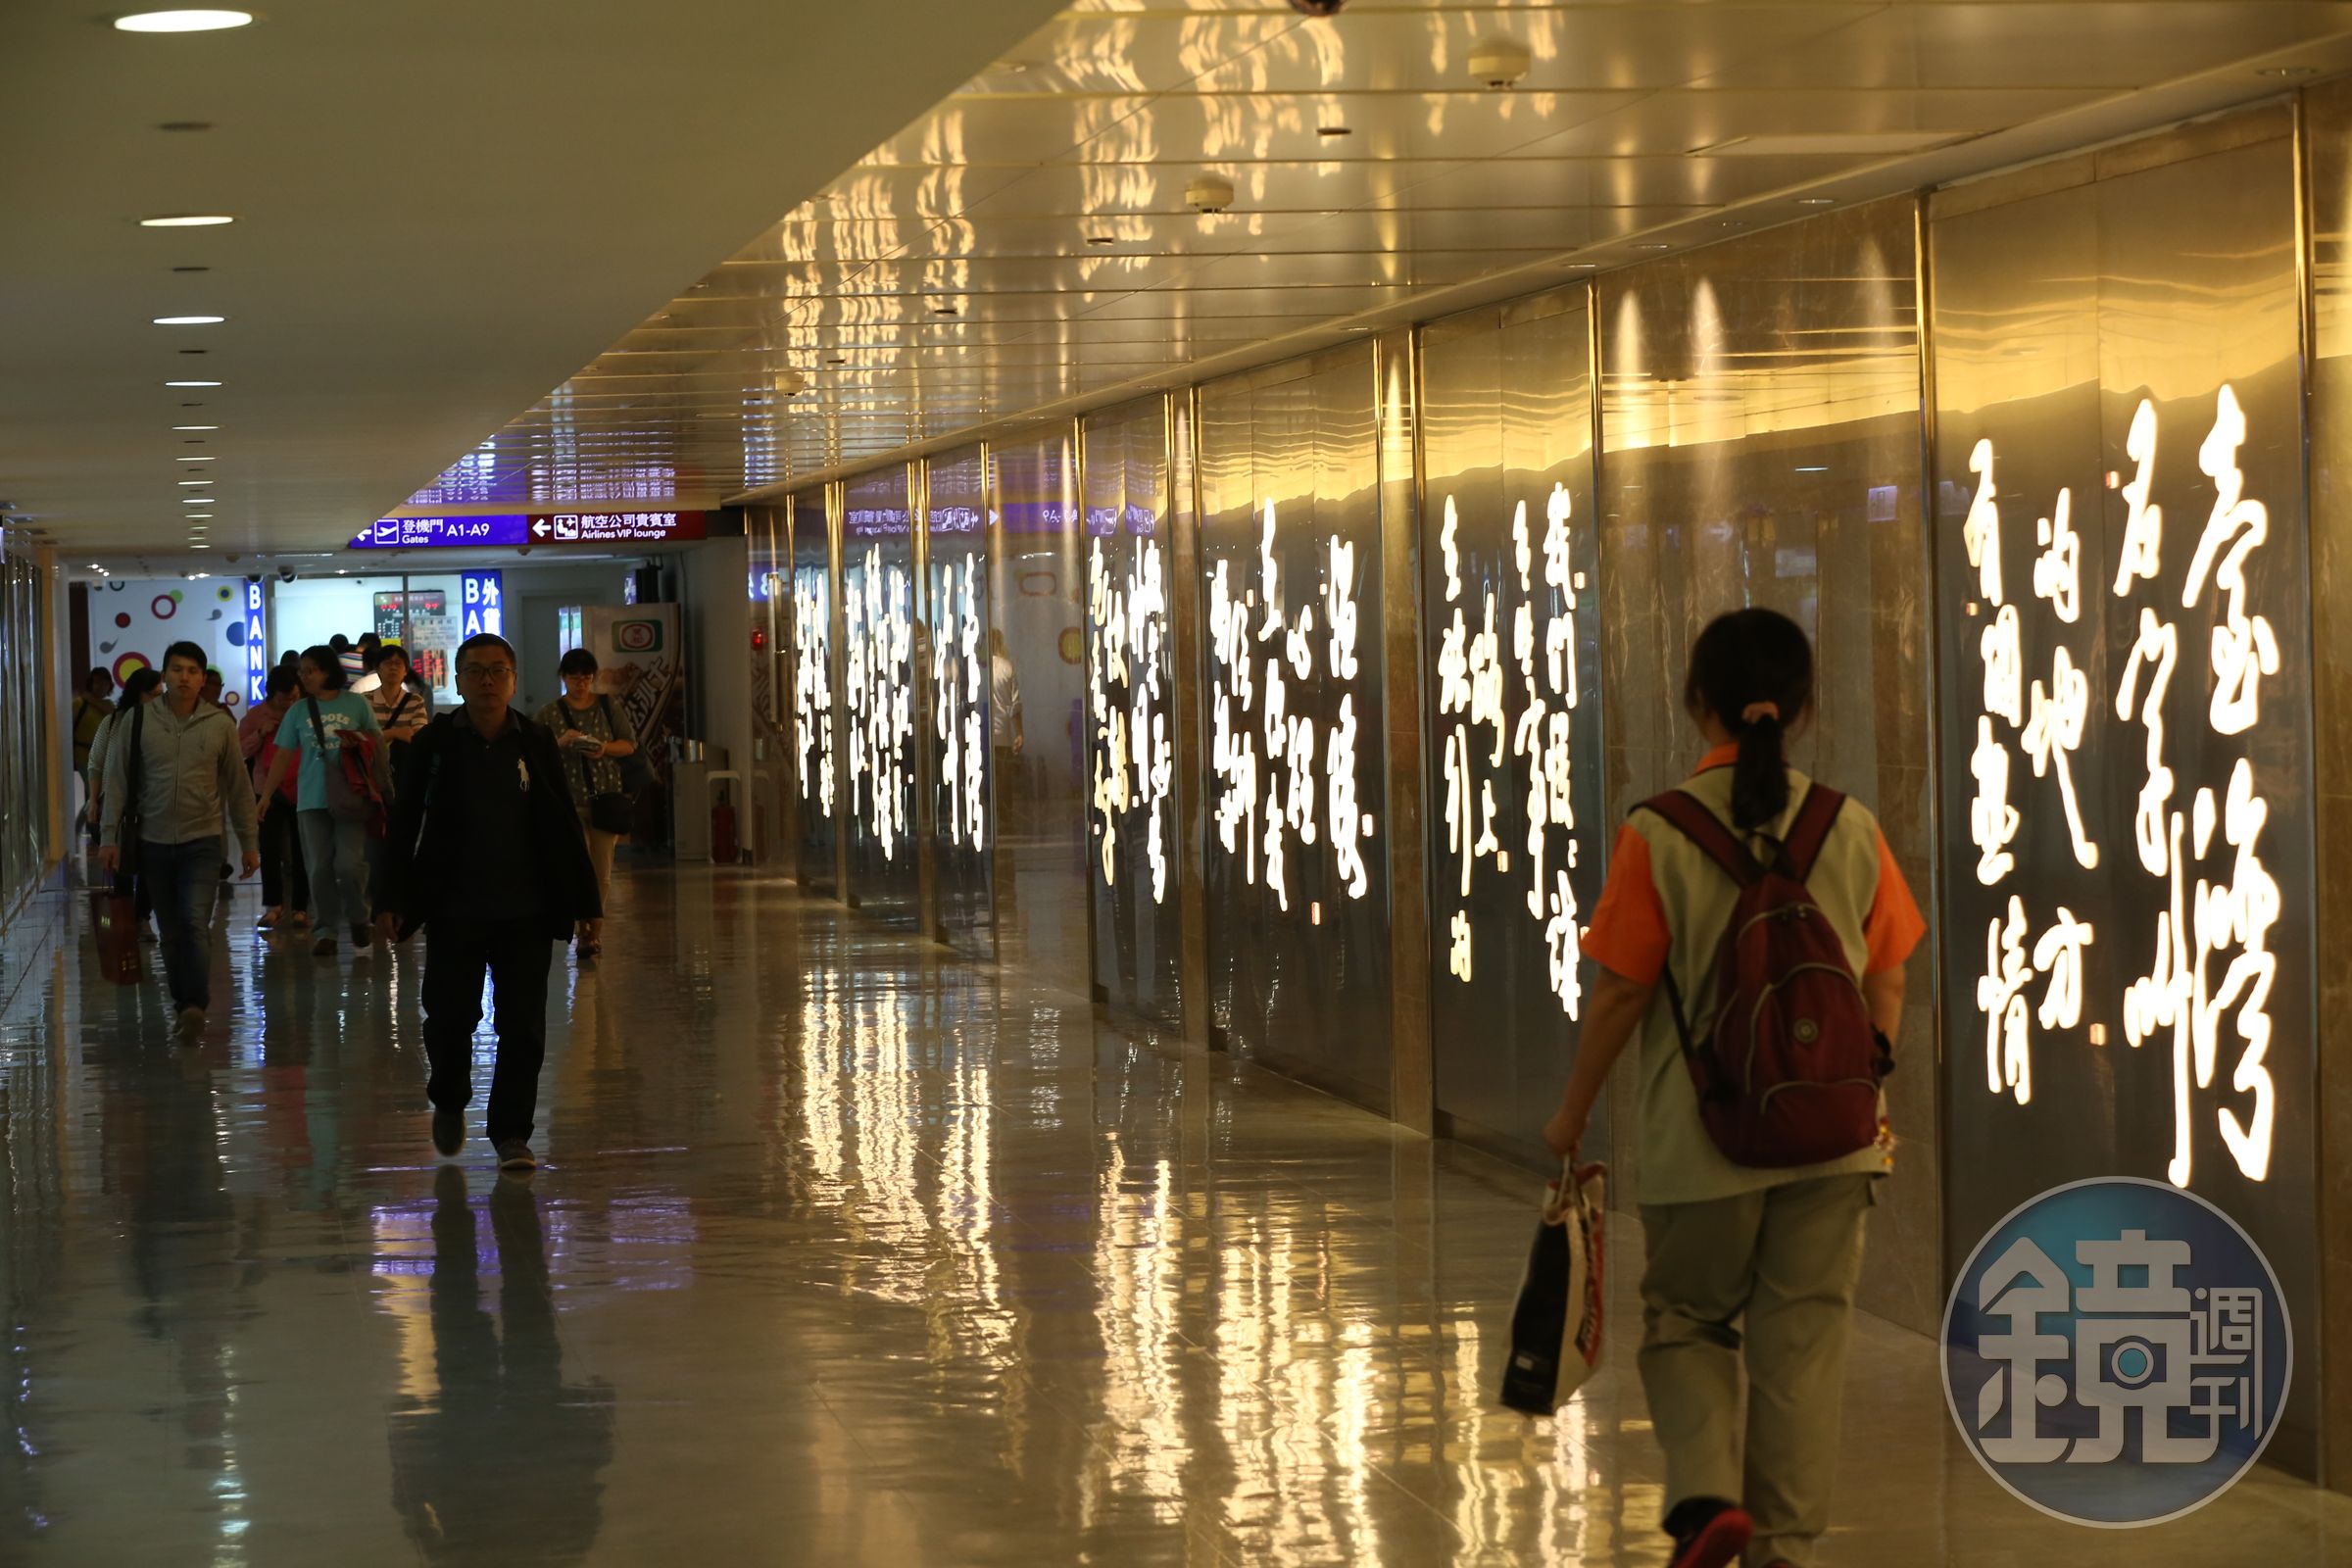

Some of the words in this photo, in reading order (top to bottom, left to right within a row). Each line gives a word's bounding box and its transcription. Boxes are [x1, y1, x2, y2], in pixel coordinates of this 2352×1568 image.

[402, 518, 443, 533] 登機門
[446, 522, 490, 537] A1-A9
[581, 514, 677, 529] 航空公司貴賓室
[402, 534, 428, 544] Gates
[581, 530, 615, 539] Airlines
[617, 529, 632, 538] VIP
[633, 528, 666, 538] lounge
[248, 584, 265, 701] BANK
